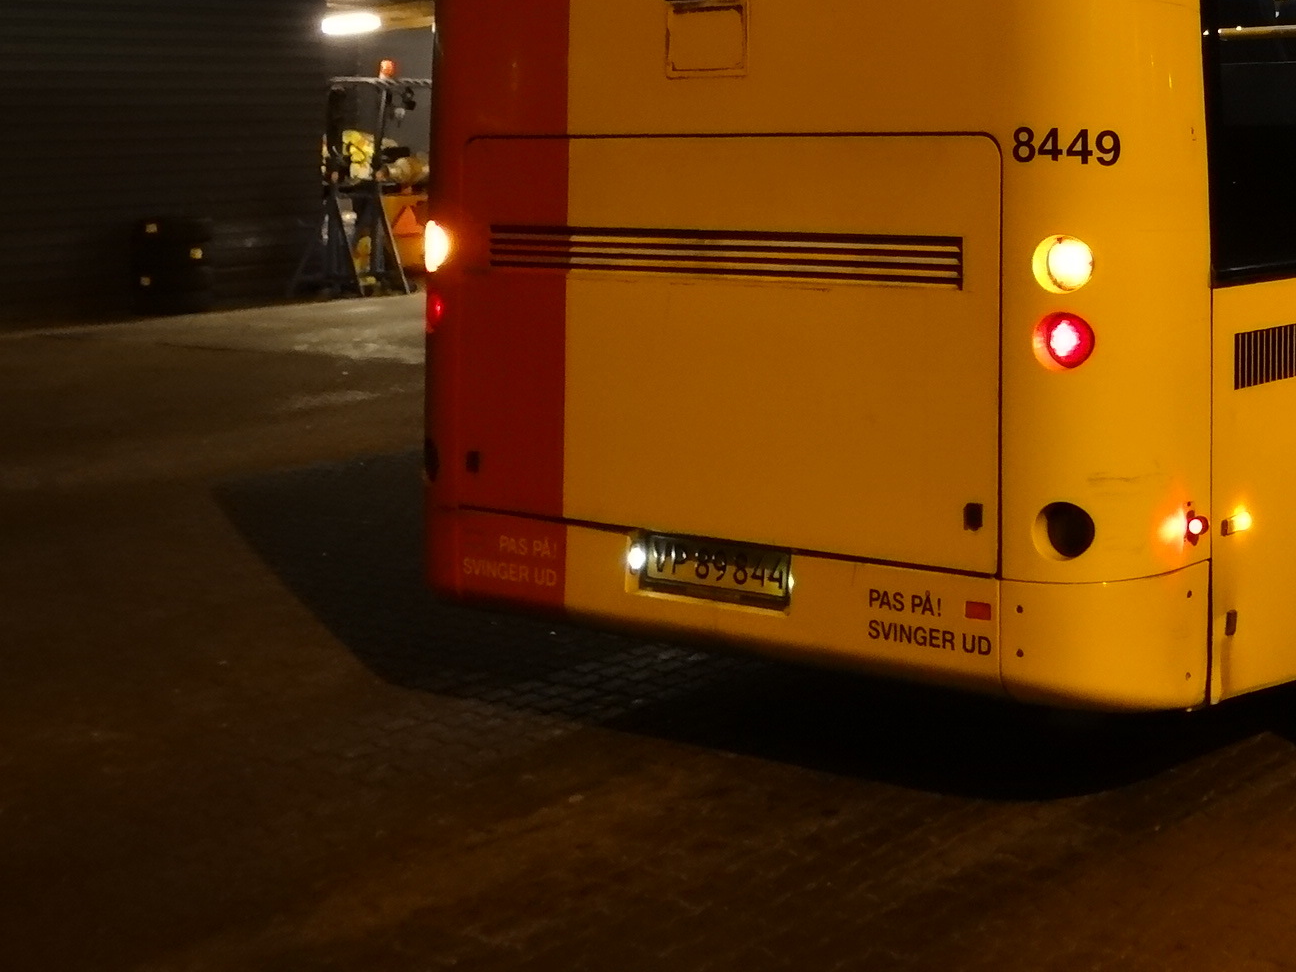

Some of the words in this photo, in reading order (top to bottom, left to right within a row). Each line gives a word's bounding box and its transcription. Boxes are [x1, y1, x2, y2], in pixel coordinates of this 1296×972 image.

[1012, 126, 1121, 167] 8449
[500, 534, 528, 556] PAS
[533, 536, 557, 559] PÅ!
[463, 556, 529, 582] SVINGER
[534, 567, 557, 587] UD
[694, 546, 727, 581] 89
[733, 552, 784, 590] 844
[869, 589, 905, 612] PAS
[911, 590, 942, 617] PÅ!
[868, 619, 955, 651] SVINGER
[962, 632, 992, 656] UD
